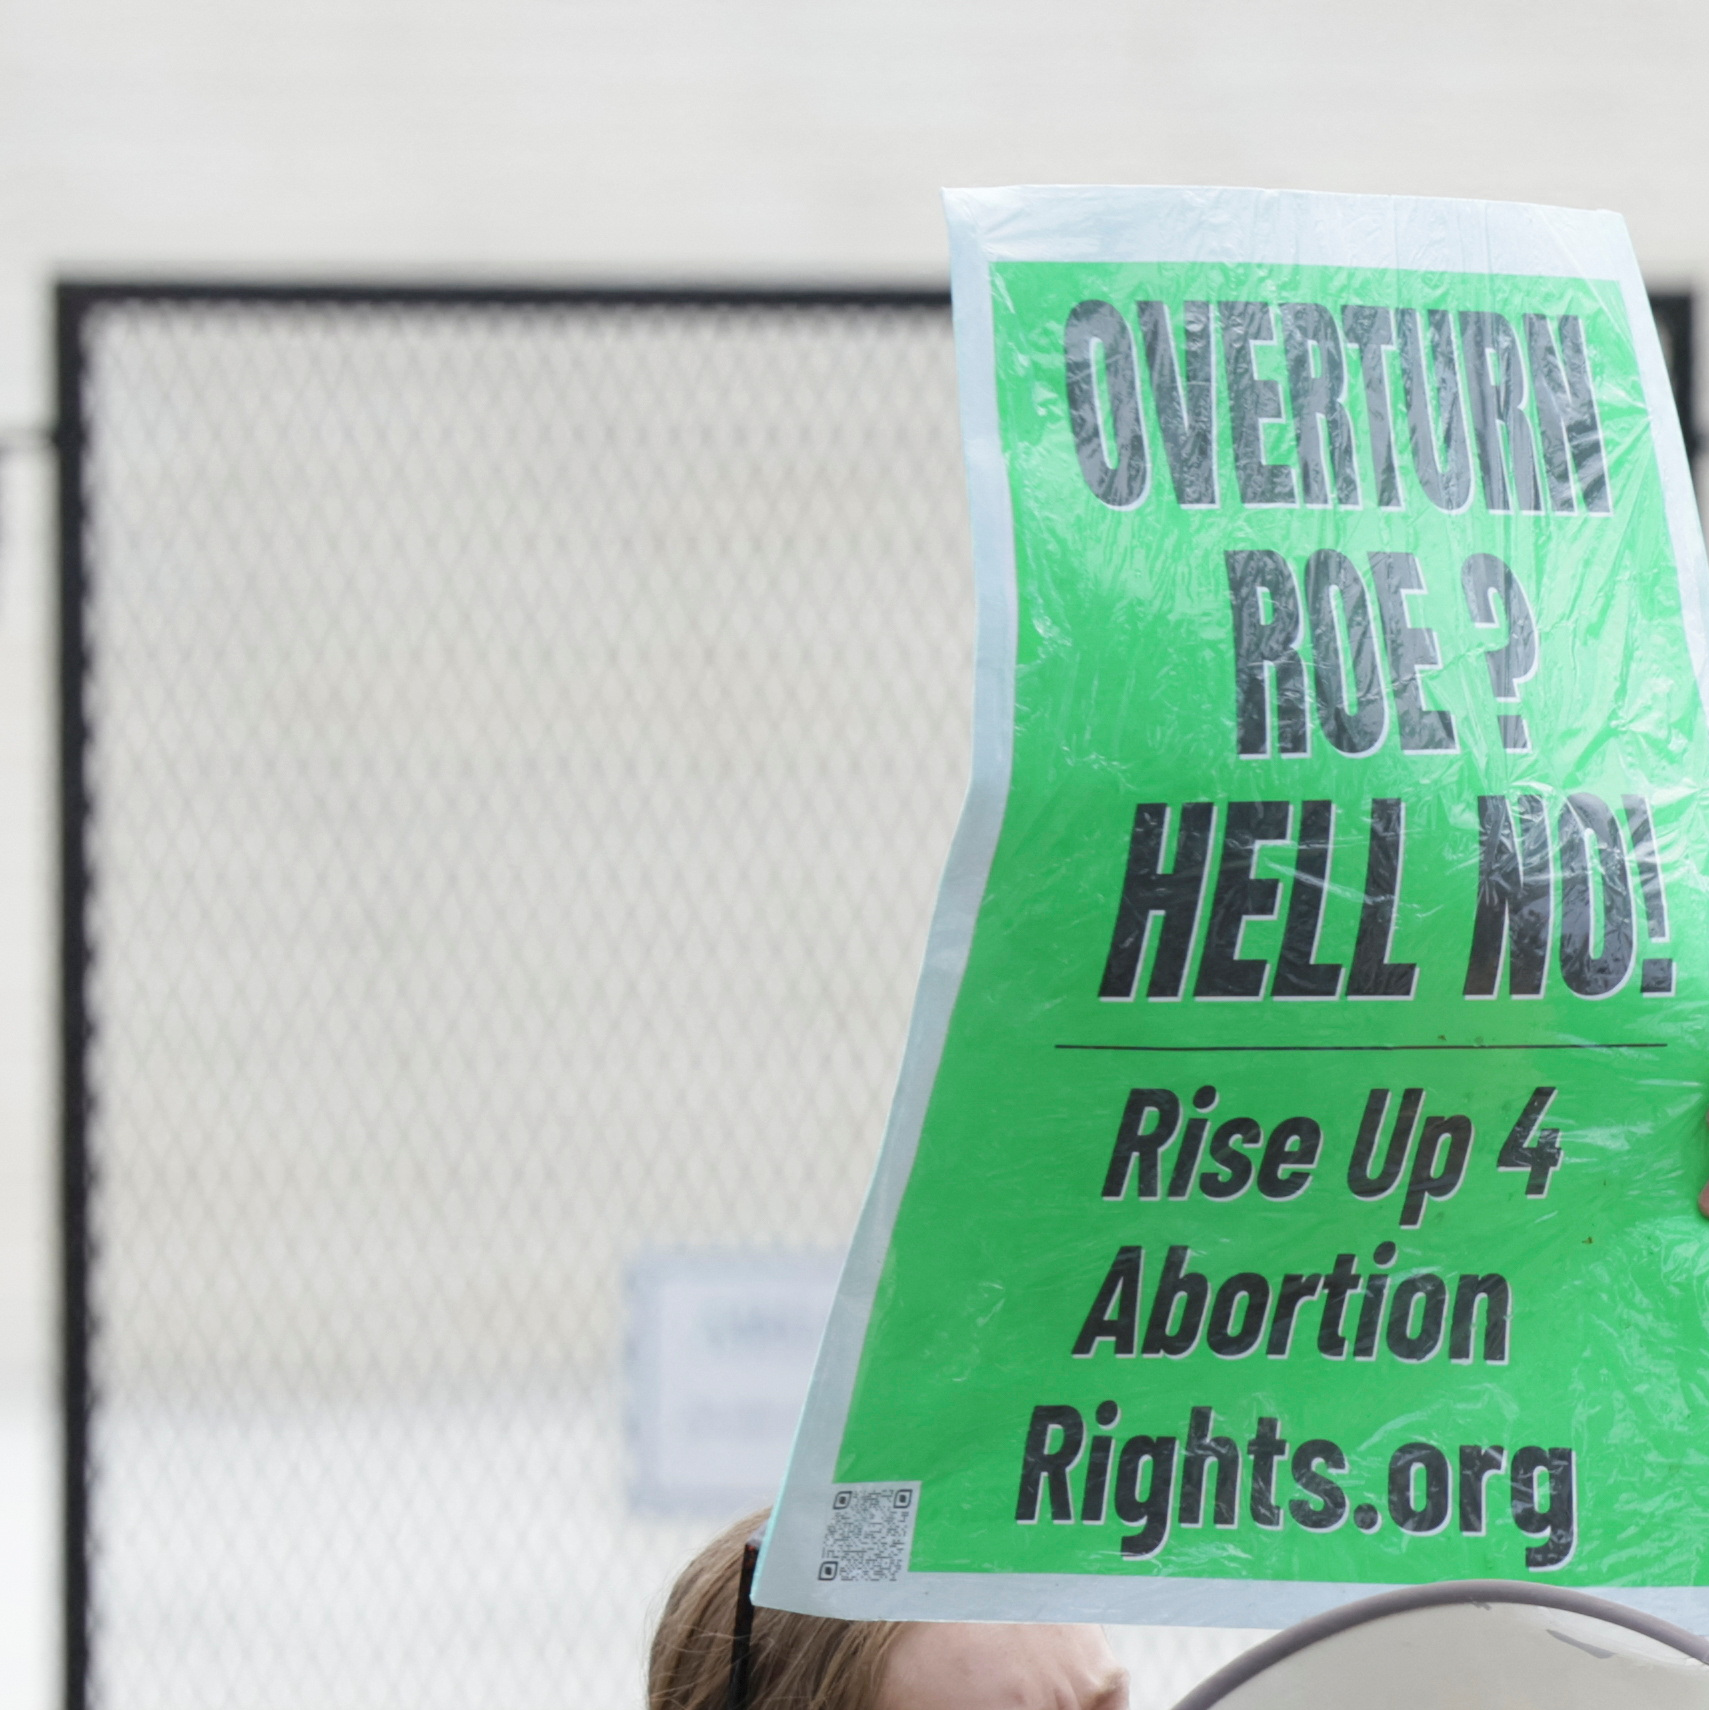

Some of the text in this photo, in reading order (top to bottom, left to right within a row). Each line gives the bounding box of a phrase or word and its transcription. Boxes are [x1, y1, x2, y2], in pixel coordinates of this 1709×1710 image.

[1062, 299, 1613, 517] OVERTURN
[1223, 548, 1540, 760] ROE ?
[1098, 792, 1677, 1000] HELL NO!
[1100, 1085, 1564, 1228] Rise Up 4
[1070, 1240, 1511, 1367] Abortion
[1013, 1405, 1579, 1572] Rights.org
